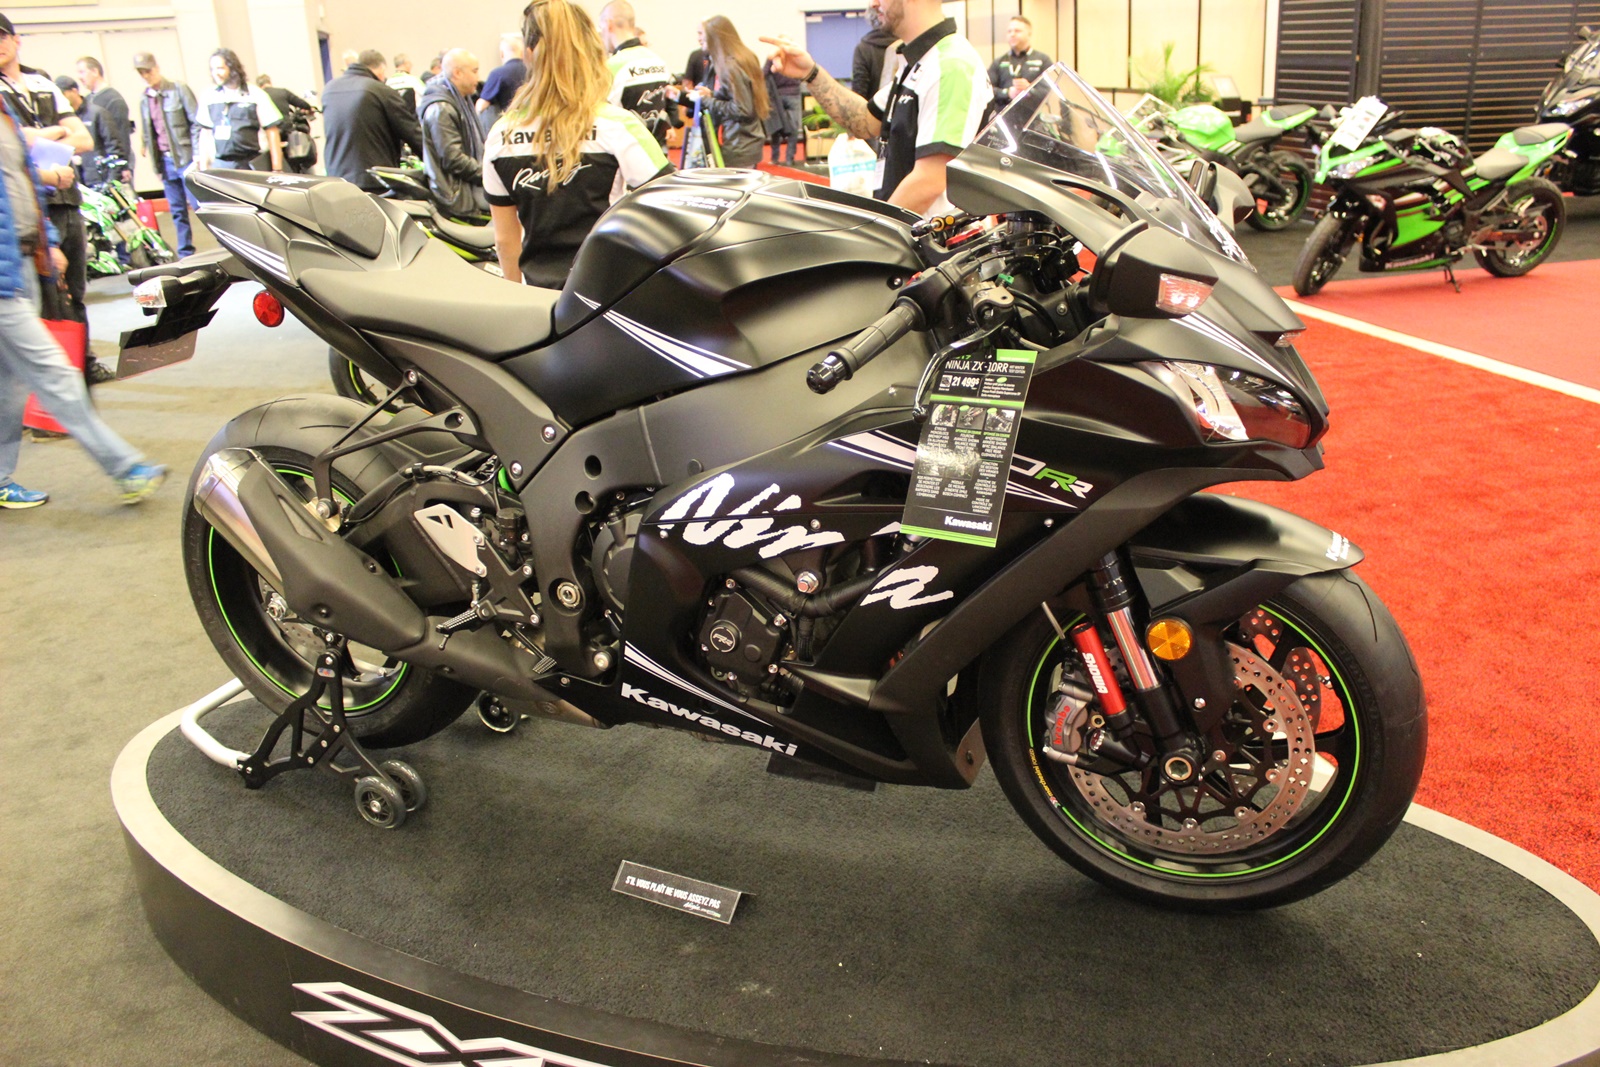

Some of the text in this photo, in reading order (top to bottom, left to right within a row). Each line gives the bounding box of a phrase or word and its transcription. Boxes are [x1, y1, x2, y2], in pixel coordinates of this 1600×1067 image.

[945, 360, 971, 371] NINJA
[944, 515, 993, 532] Kawasaki
[1082, 652, 1109, 694] SHOWA
[620, 682, 798, 757] Kawasaki
[1053, 705, 1071, 745] brembo
